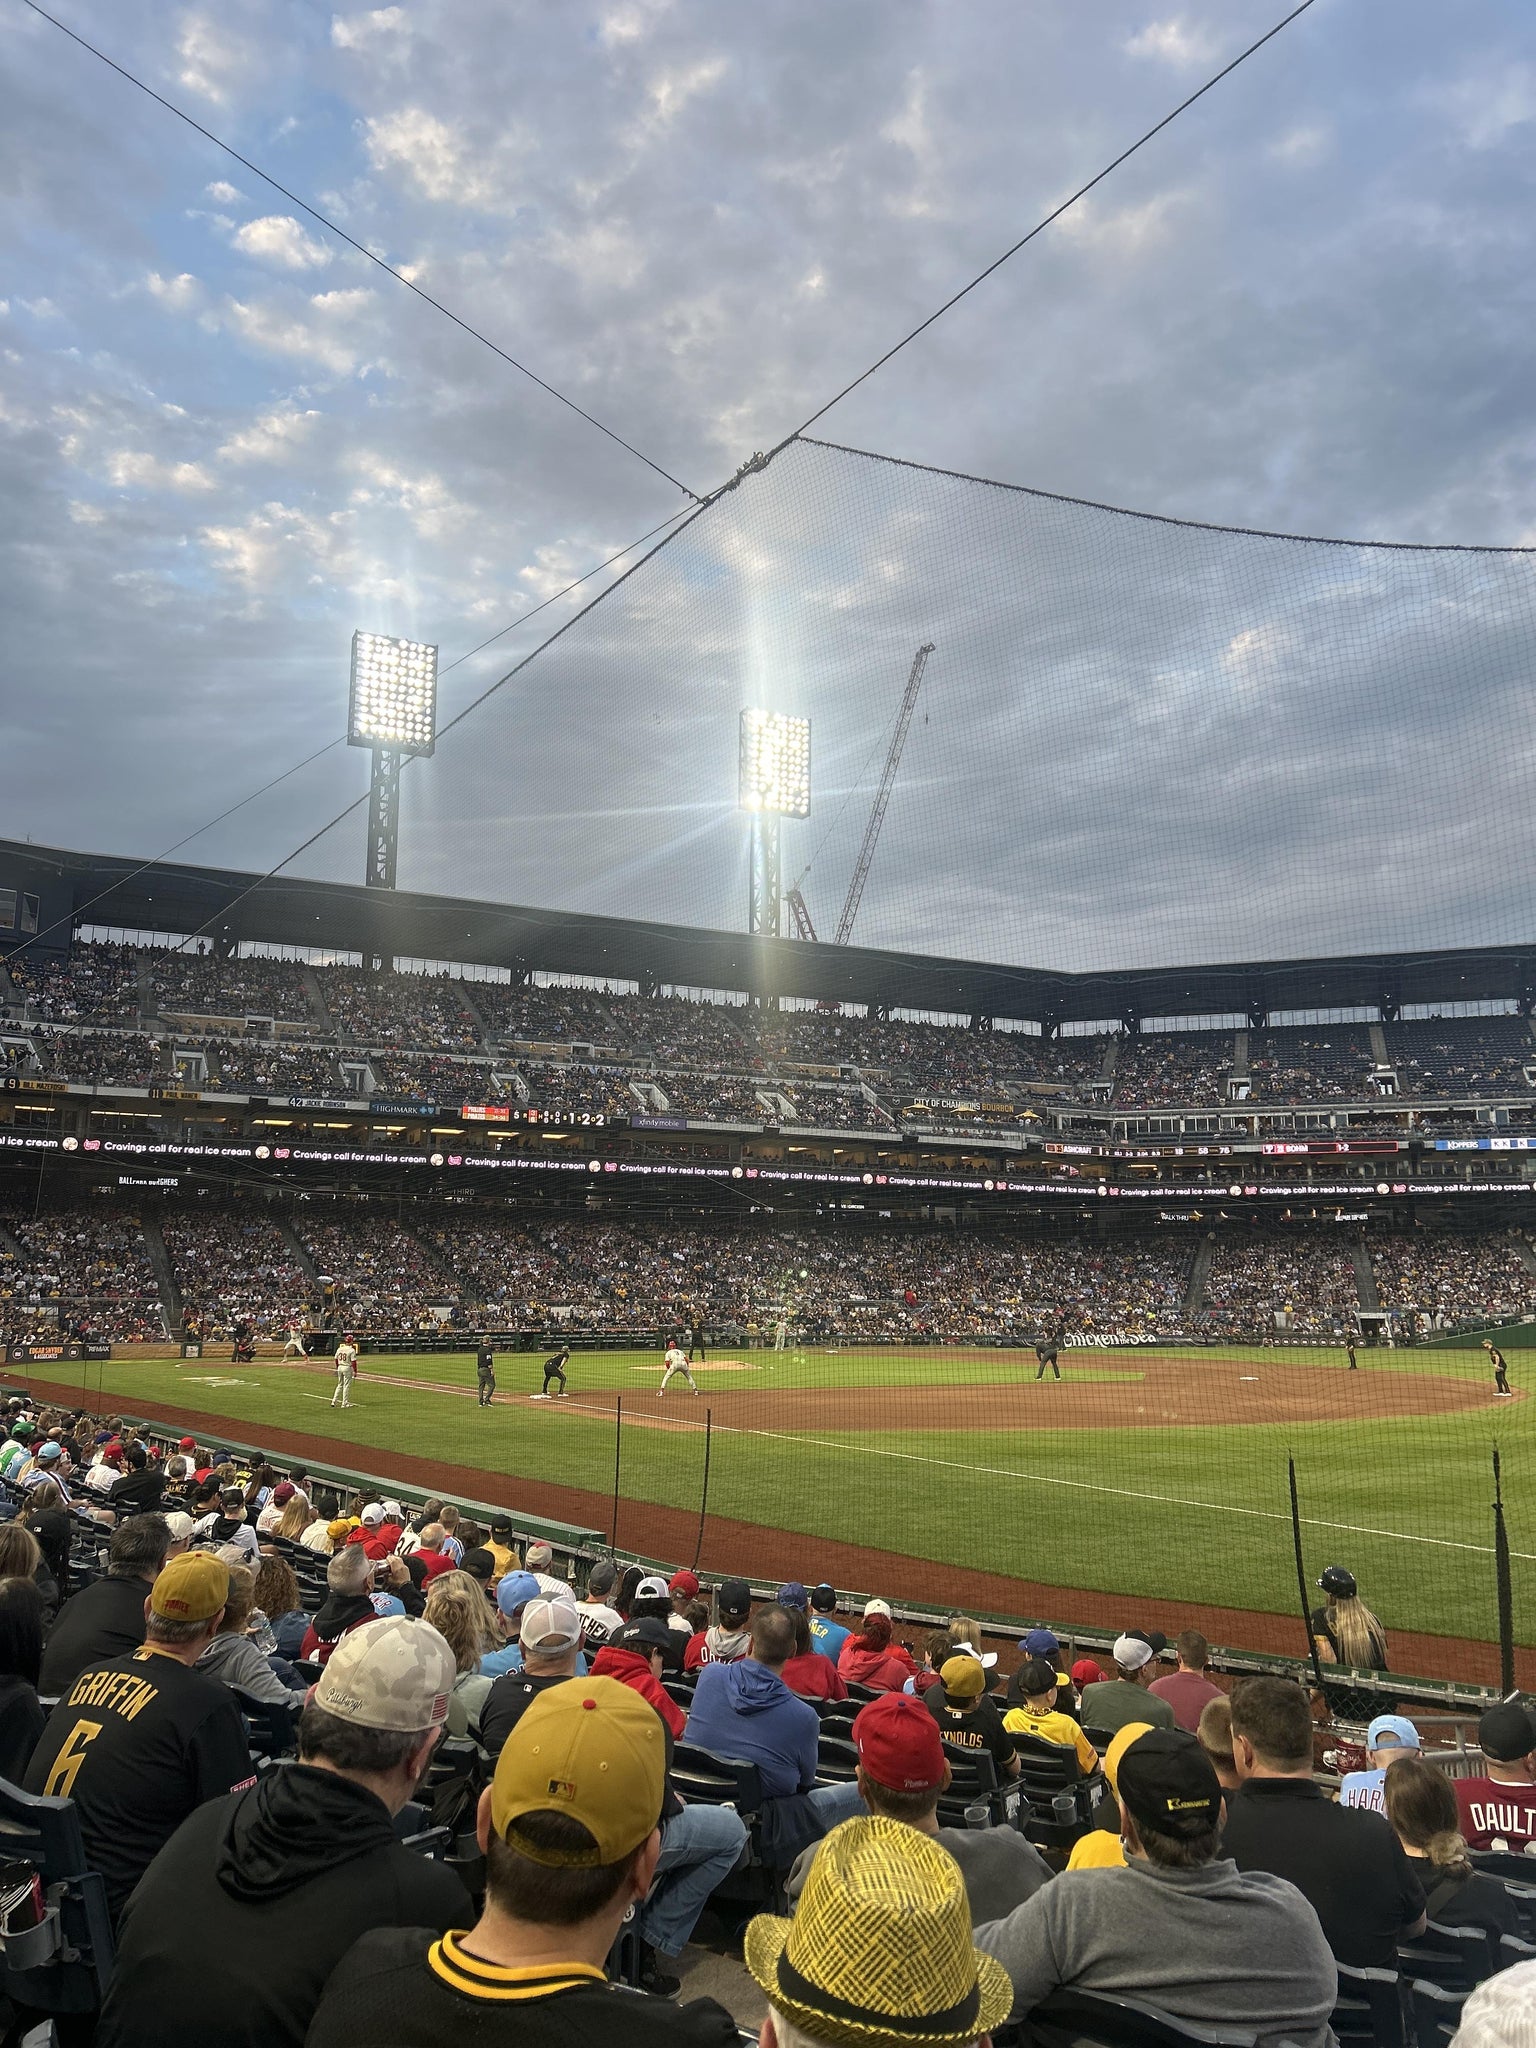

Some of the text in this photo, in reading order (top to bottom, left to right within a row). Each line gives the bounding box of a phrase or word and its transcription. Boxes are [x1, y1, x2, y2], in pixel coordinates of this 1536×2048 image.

[289, 1097, 302, 1107] 42
[931, 1099, 940, 1107] OF
[376, 1105, 418, 1114] HIGHMARK
[570, 1112, 575, 1124] 1
[582, 1113, 591, 1125] 2
[595, 1114, 604, 1126] 2
[8, 1135, 23, 1146] ice
[26, 1139, 58, 1148] cream
[1448, 1140, 1479, 1150] KOPPERS
[104, 1141, 146, 1154] Cravings
[149, 1143, 166, 1153] call
[168, 1144, 182, 1154] for
[184, 1144, 203, 1155] real
[205, 1145, 219, 1155] ice
[221, 1148, 251, 1157] cream
[293, 1149, 332, 1162] Cravings
[334, 1152, 349, 1161] call
[351, 1152, 364, 1161] for
[366, 1153, 383, 1162] real
[385, 1153, 398, 1163] ice
[400, 1156, 426, 1164] cream
[465, 1157, 500, 1168] Cravings
[501, 1159, 516, 1167] call
[518, 1159, 529, 1168] for
[531, 1160, 546, 1169] real
[548, 1160, 559, 1169] ice
[561, 1162, 585, 1170] cream
[620, 1163, 651, 1175] Cravings
[667, 1165, 678, 1174] for
[760, 1170, 789, 1181] Cravings
[804, 1172, 813, 1180] for
[889, 1176, 916, 1187] Cravings
[929, 1178, 938, 1186] for
[1008, 1182, 1034, 1193] Cravings
[1046, 1184, 1055, 1192] for
[1121, 1188, 1149, 1197] Cravings
[1165, 1188, 1175, 1196] for
[1260, 1186, 1292, 1196] Cravings
[1308, 1185, 1319, 1194] for
[1409, 1184, 1442, 1194] Cravings
[1459, 1183, 1471, 1192] for
[67, 1671, 159, 1722] GRIFFIN
[42, 1718, 103, 1798] 6
